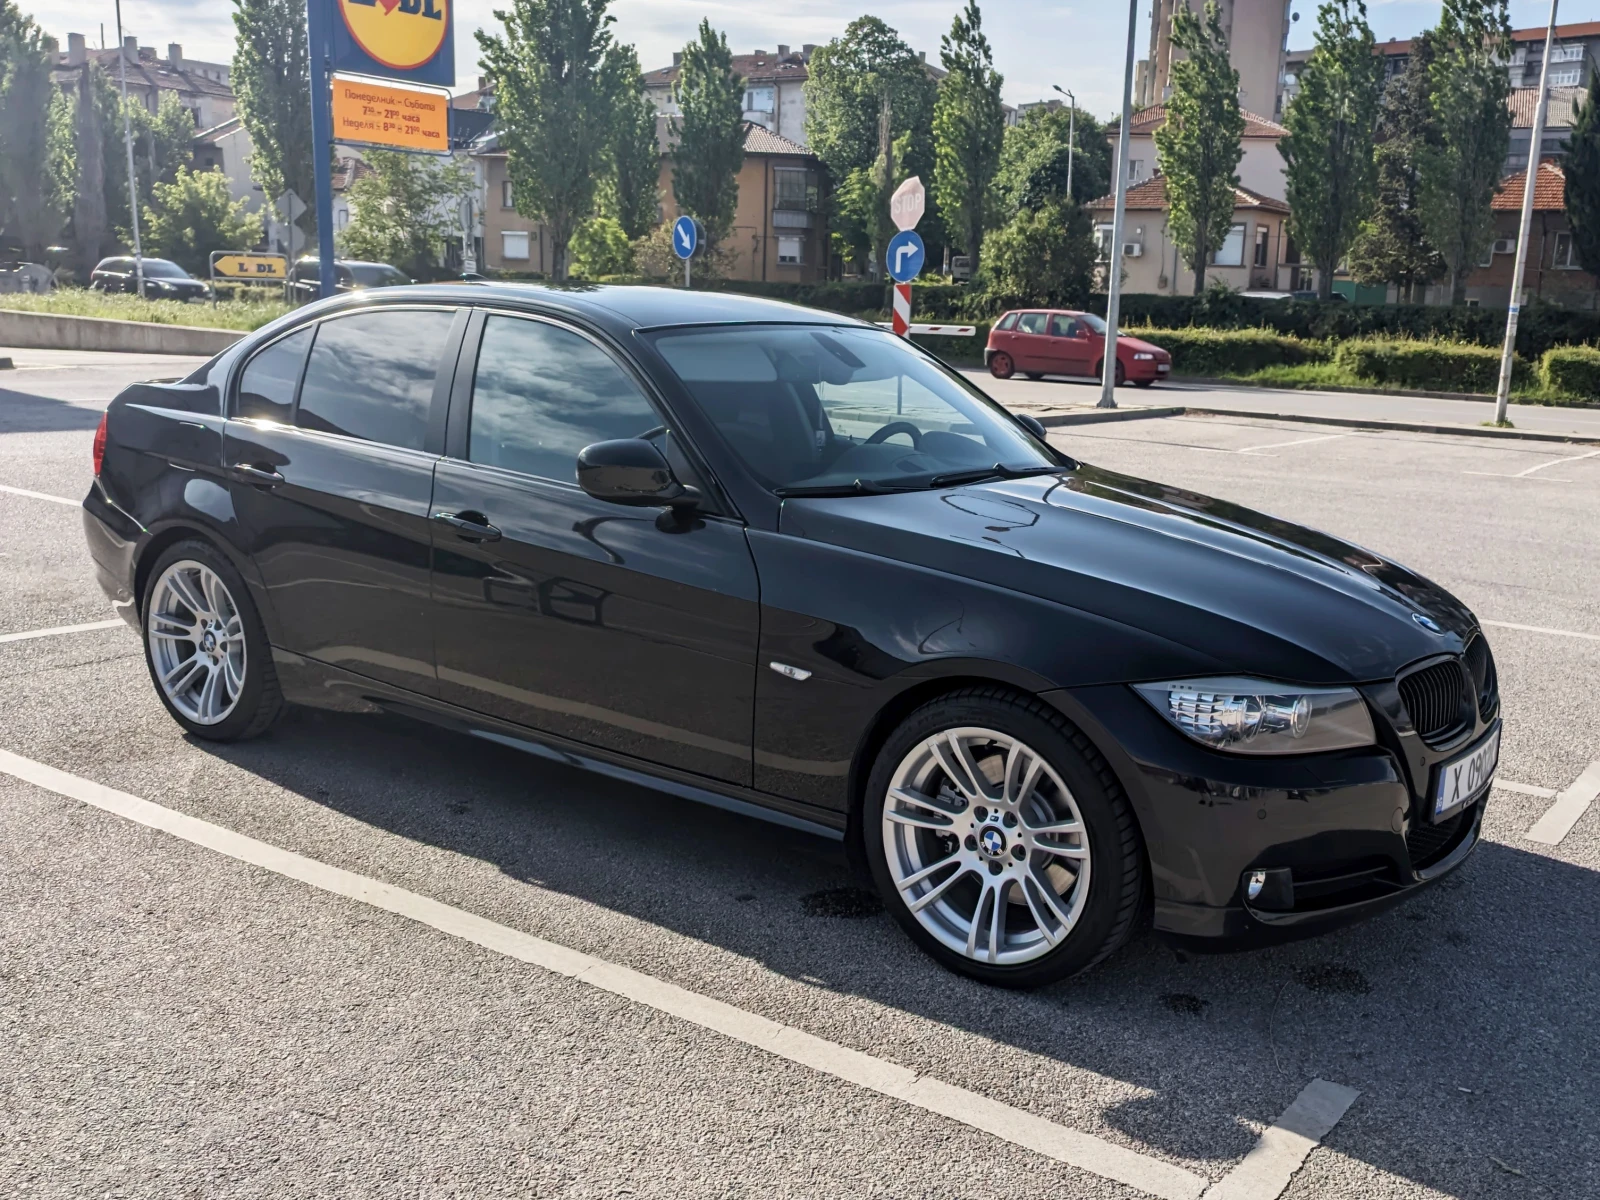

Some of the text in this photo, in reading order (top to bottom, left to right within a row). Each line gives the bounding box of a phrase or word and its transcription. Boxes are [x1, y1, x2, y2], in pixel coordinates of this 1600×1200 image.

[345, 89, 395, 104] Понеделник
[404, 98, 436, 111] Събота
[343, 117, 374, 130] Неделя
[422, 130, 440, 138] часа
[402, 114, 420, 123] часа
[895, 194, 921, 214] STOP
